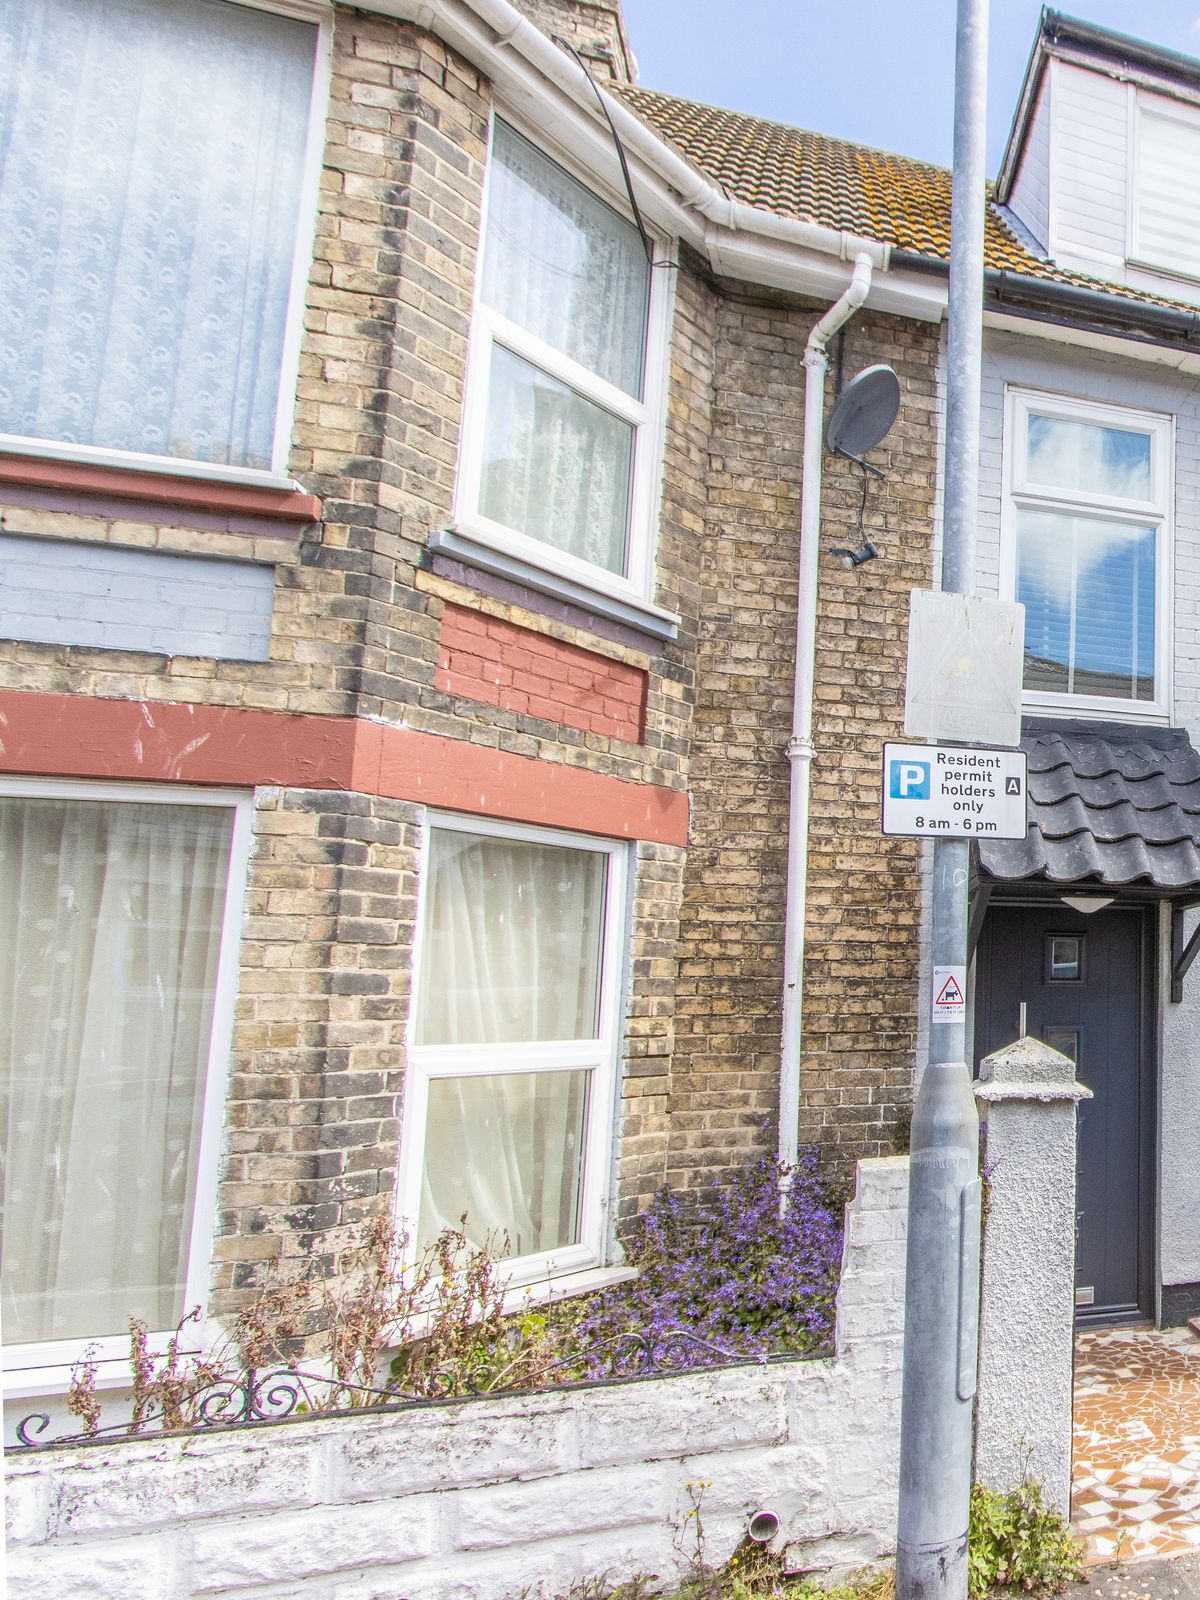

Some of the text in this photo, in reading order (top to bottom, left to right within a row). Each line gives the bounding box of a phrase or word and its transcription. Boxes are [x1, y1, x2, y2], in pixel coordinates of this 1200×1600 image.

[937, 753, 1000, 768] Resident
[900, 764, 925, 796] P
[944, 770, 992, 782] permit
[941, 784, 995, 797] holders
[1007, 779, 1019, 793] A
[953, 800, 983, 813] only
[915, 816, 924, 828] 8
[929, 819, 950, 828] am
[963, 818, 972, 830] 6
[976, 821, 997, 832] pm
